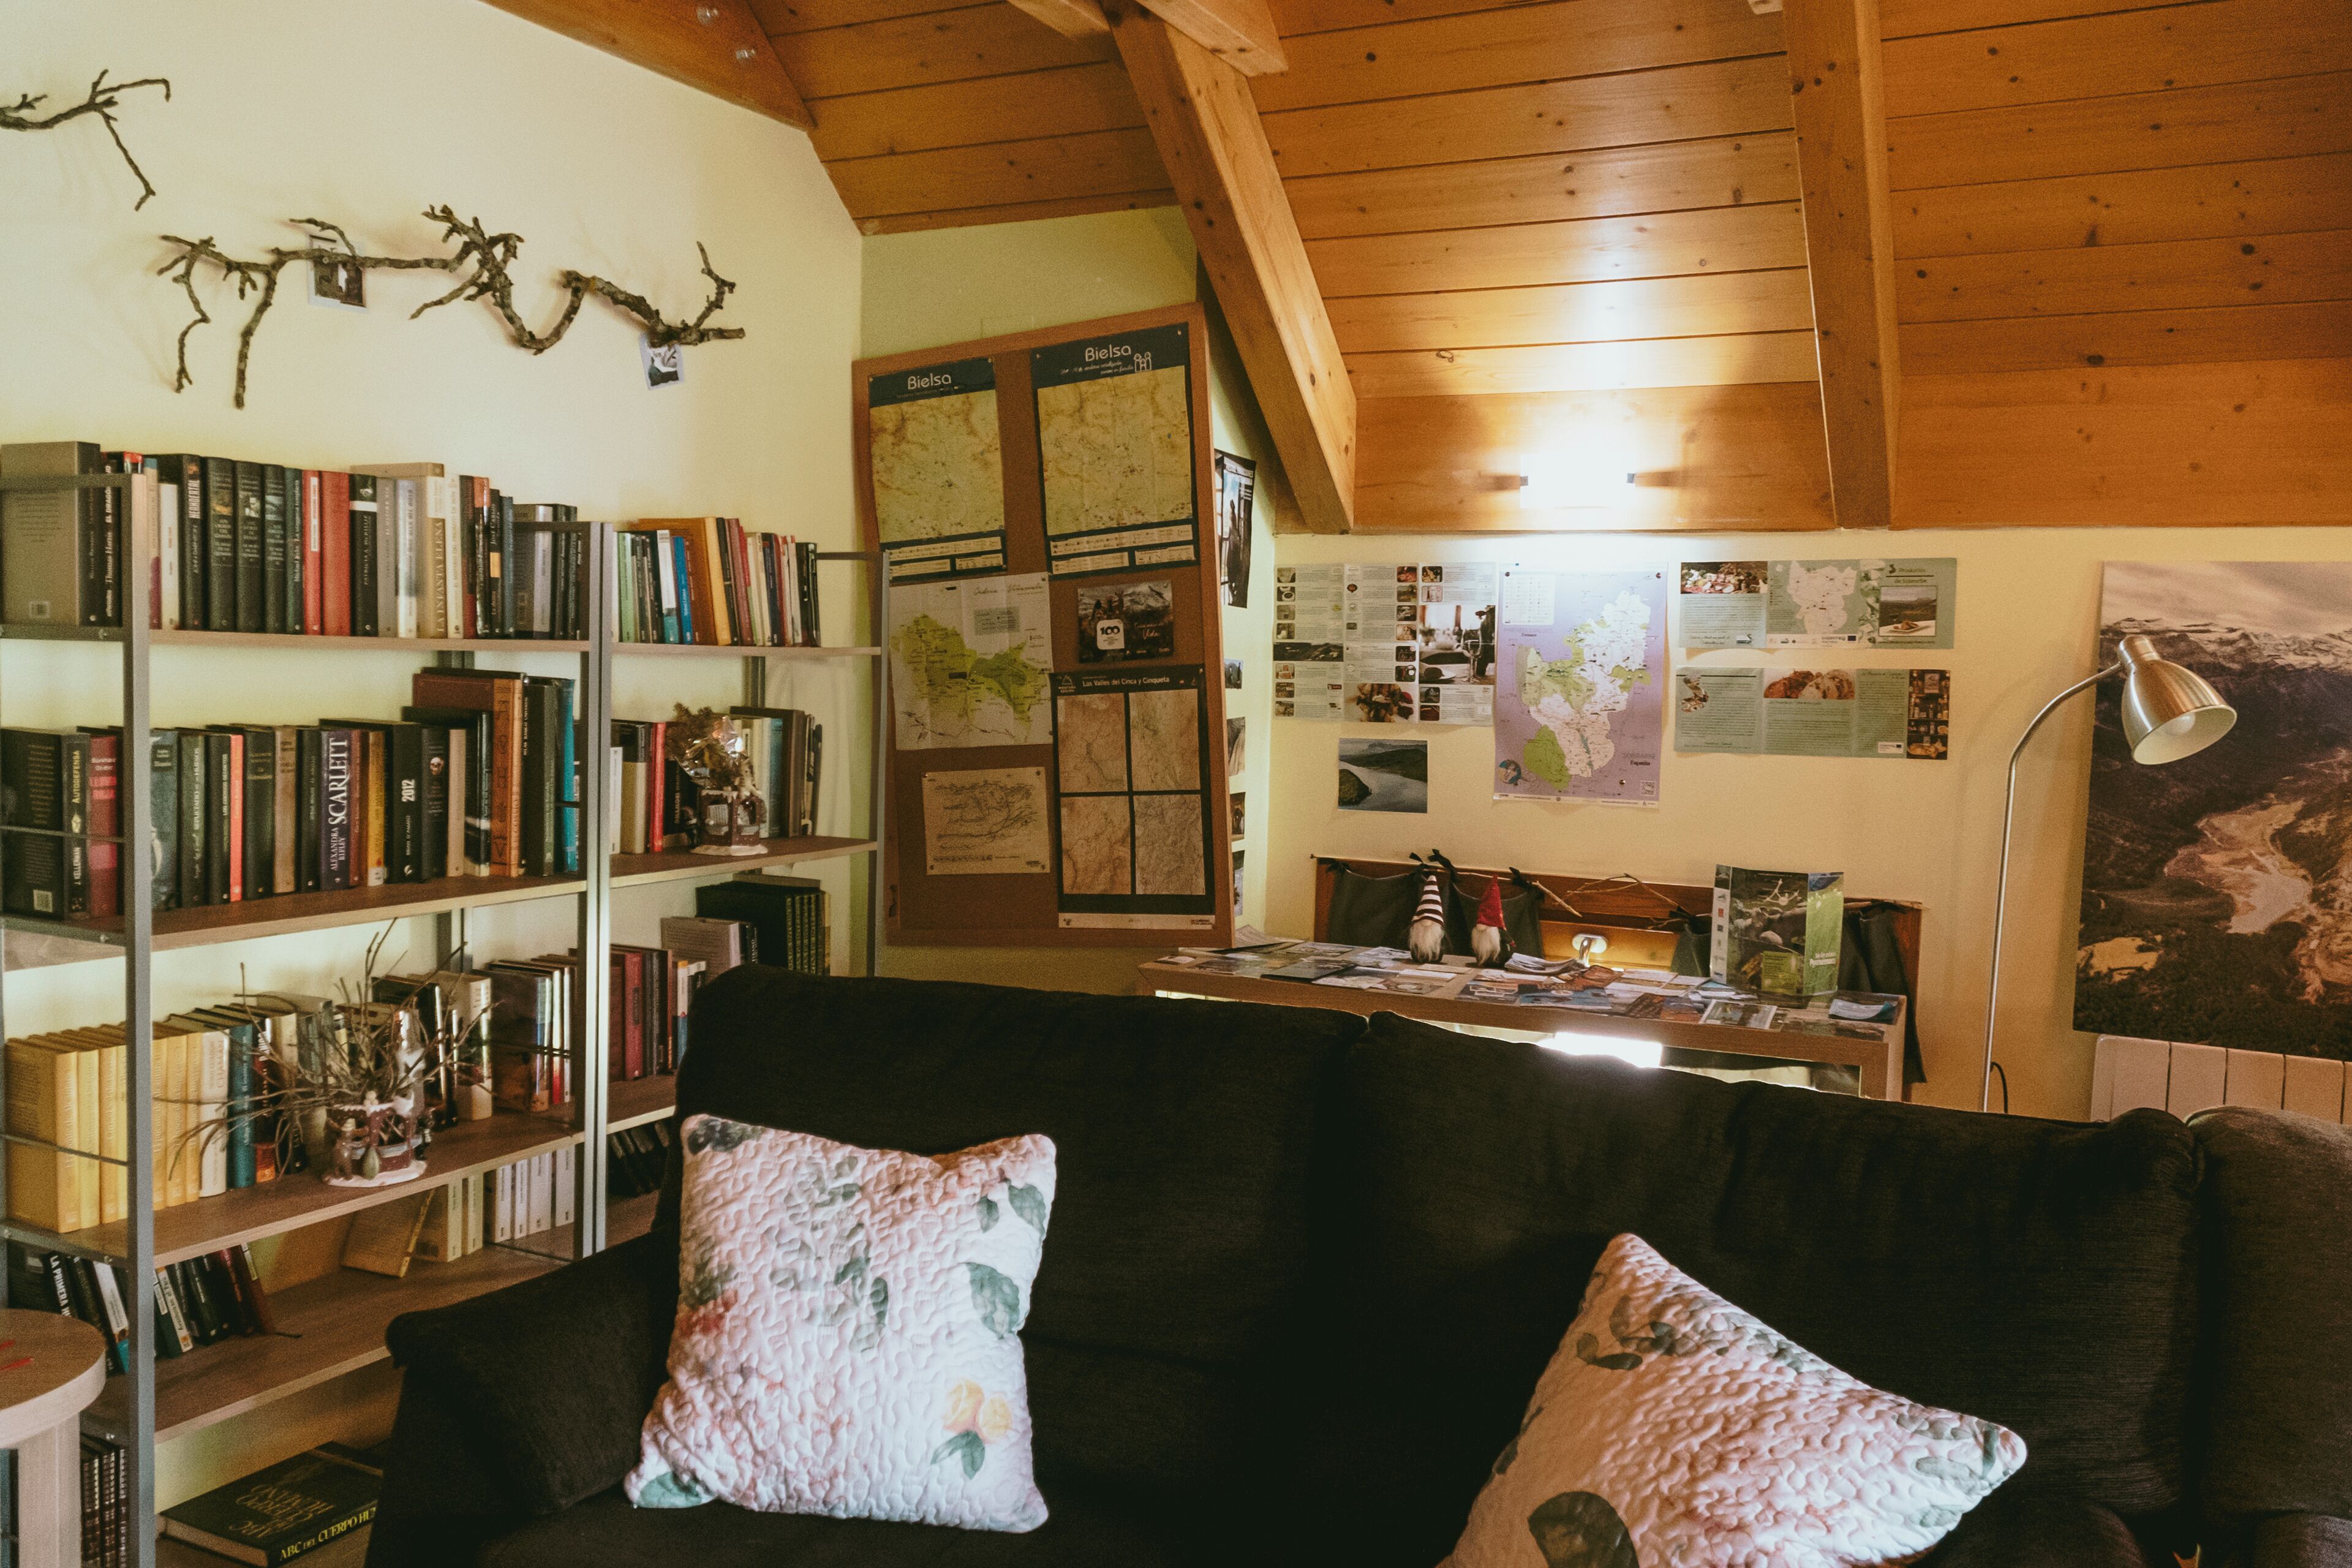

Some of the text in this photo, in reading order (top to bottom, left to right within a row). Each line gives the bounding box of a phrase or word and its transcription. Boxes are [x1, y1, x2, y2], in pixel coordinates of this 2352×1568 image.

[1085, 344, 1132, 362] Bielsa
[908, 372, 952, 390] Bielsa
[104, 486, 113, 514] DRAGÓ
[187, 480, 201, 519] NEANDERTAL
[434, 521, 443, 560] ELENA
[435, 564, 445, 613] INFANTA
[1099, 625, 1121, 636] 100
[1143, 676, 1170, 685] Cinqueta
[72, 750, 81, 804] AUTODEFENSA
[327, 737, 350, 825] SCARLETT
[401, 779, 416, 802] 2012
[72, 846, 81, 880] KELLERMAN
[330, 827, 339, 871] ALEXANDRA
[337, 837, 346, 861] RIPLEY
[50, 1254, 60, 1269] LA
[53, 1267, 69, 1307] PRIMERA
[279, 1541, 301, 1561] ABC
[317, 1515, 358, 1542] CUERPO
